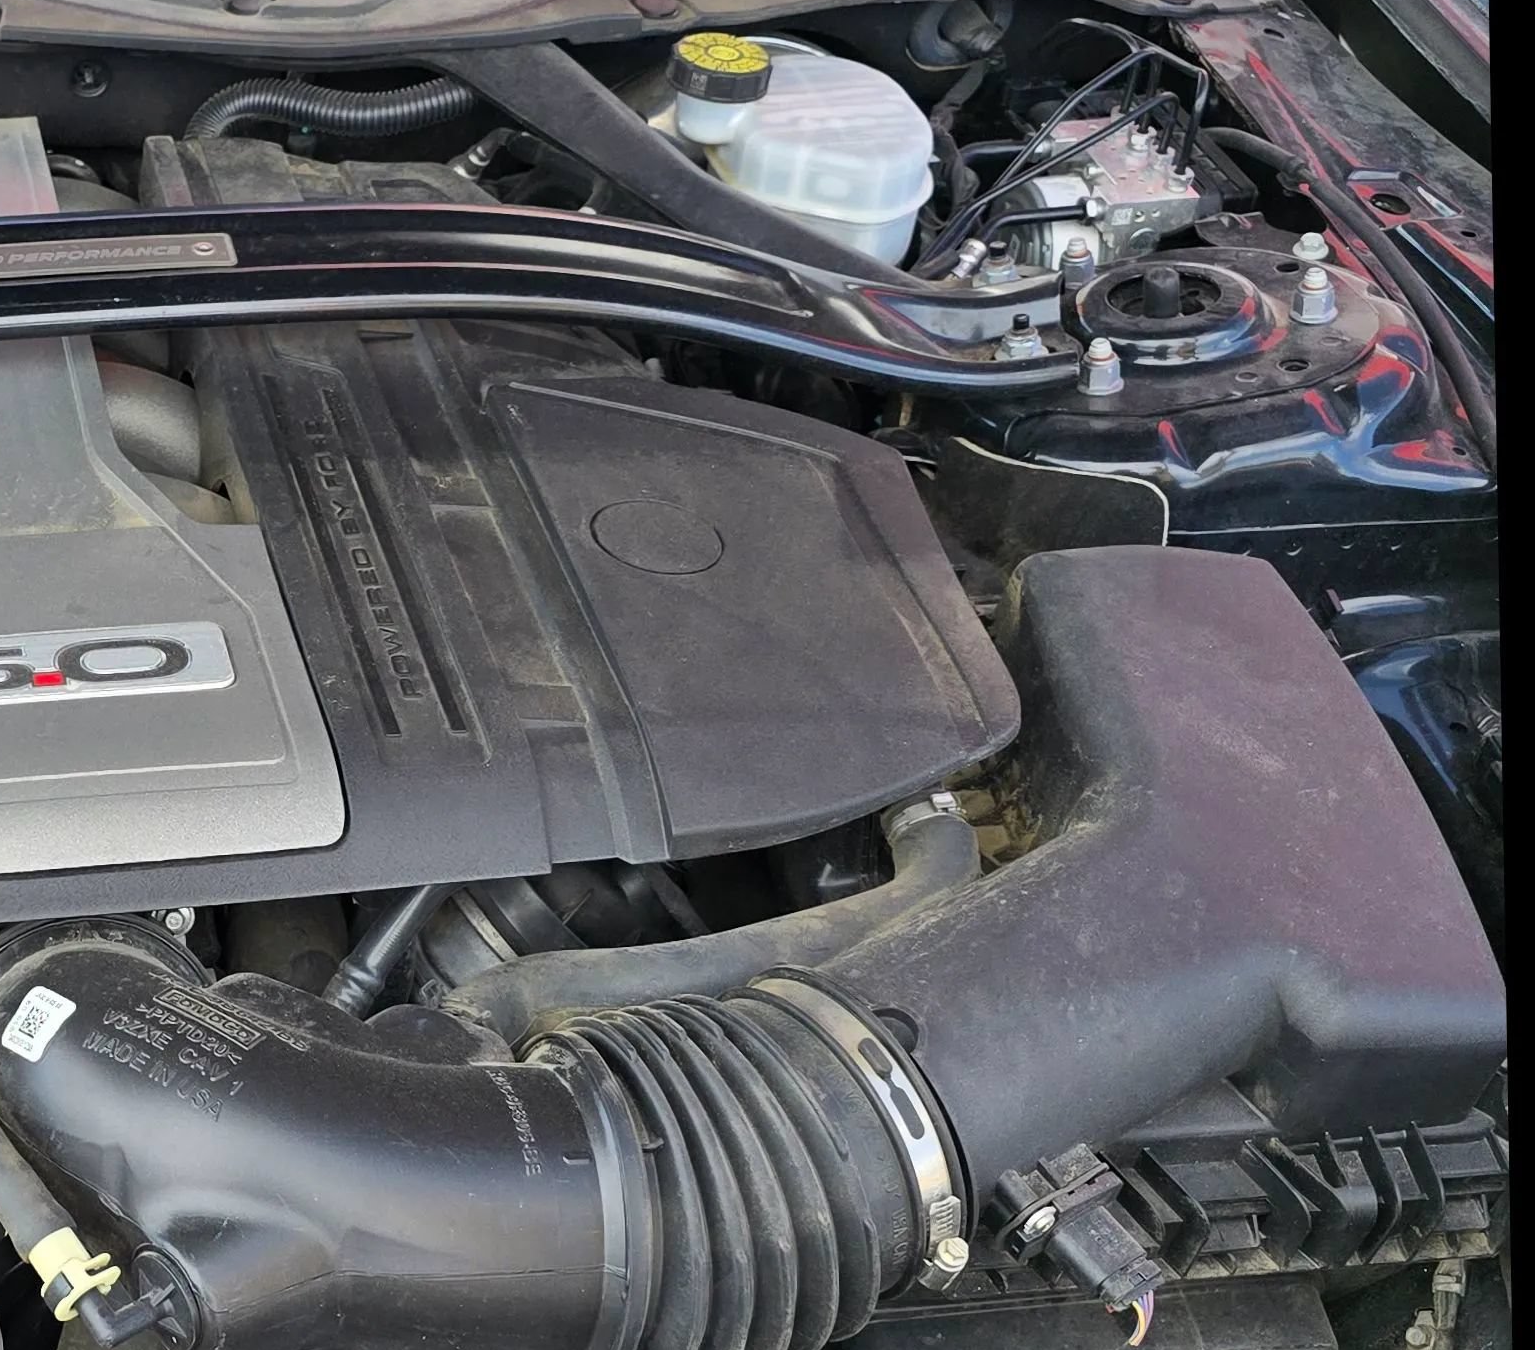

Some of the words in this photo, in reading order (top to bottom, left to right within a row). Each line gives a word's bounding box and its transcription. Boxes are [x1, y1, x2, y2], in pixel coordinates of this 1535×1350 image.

[7, 245, 182, 265] PERFORMANCE
[329, 499, 362, 537] BY
[351, 546, 424, 702] POWERED
[81, 1028, 151, 1074] MADE
[148, 1060, 179, 1089] IN
[176, 1079, 226, 1123] USA
